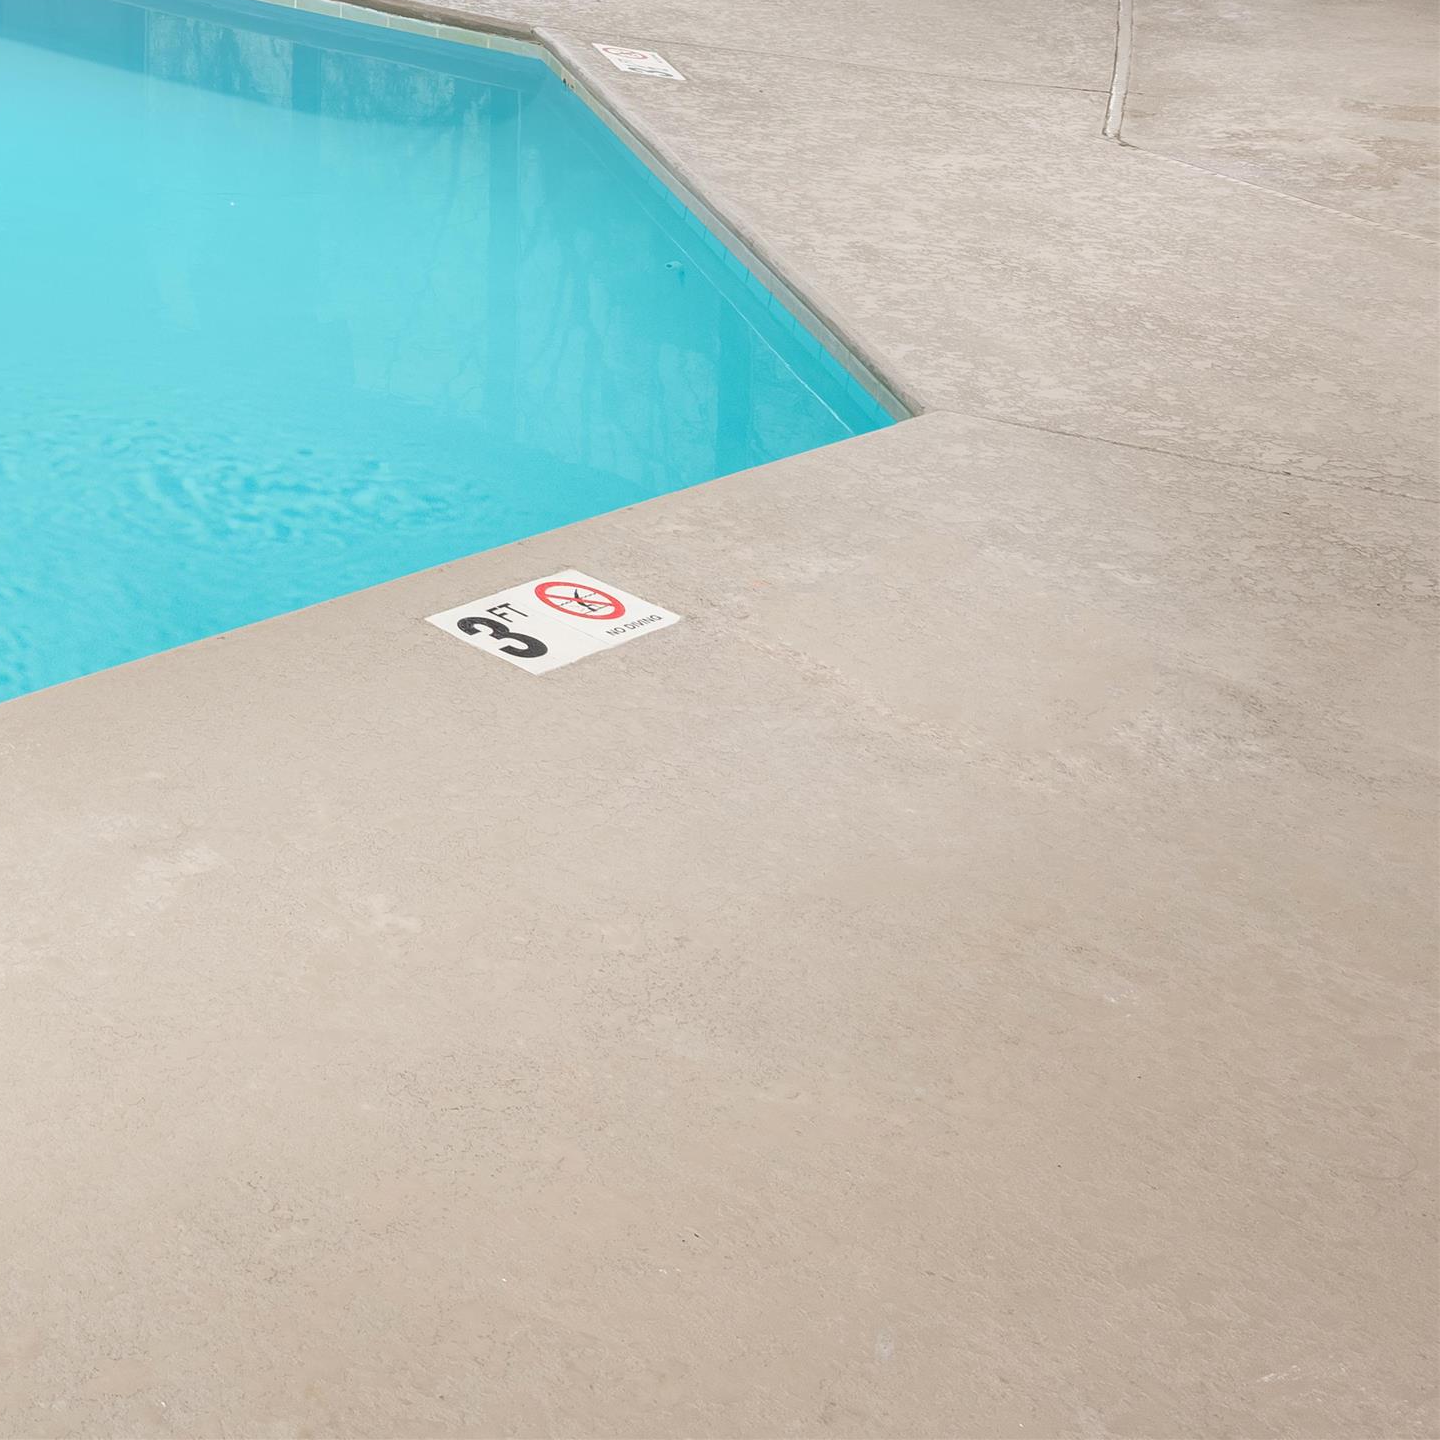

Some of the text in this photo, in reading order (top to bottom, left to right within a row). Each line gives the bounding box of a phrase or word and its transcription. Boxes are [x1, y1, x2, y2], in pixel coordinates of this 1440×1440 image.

[456, 602, 548, 658] 3 FT
[605, 614, 663, 636] NO DIVING
